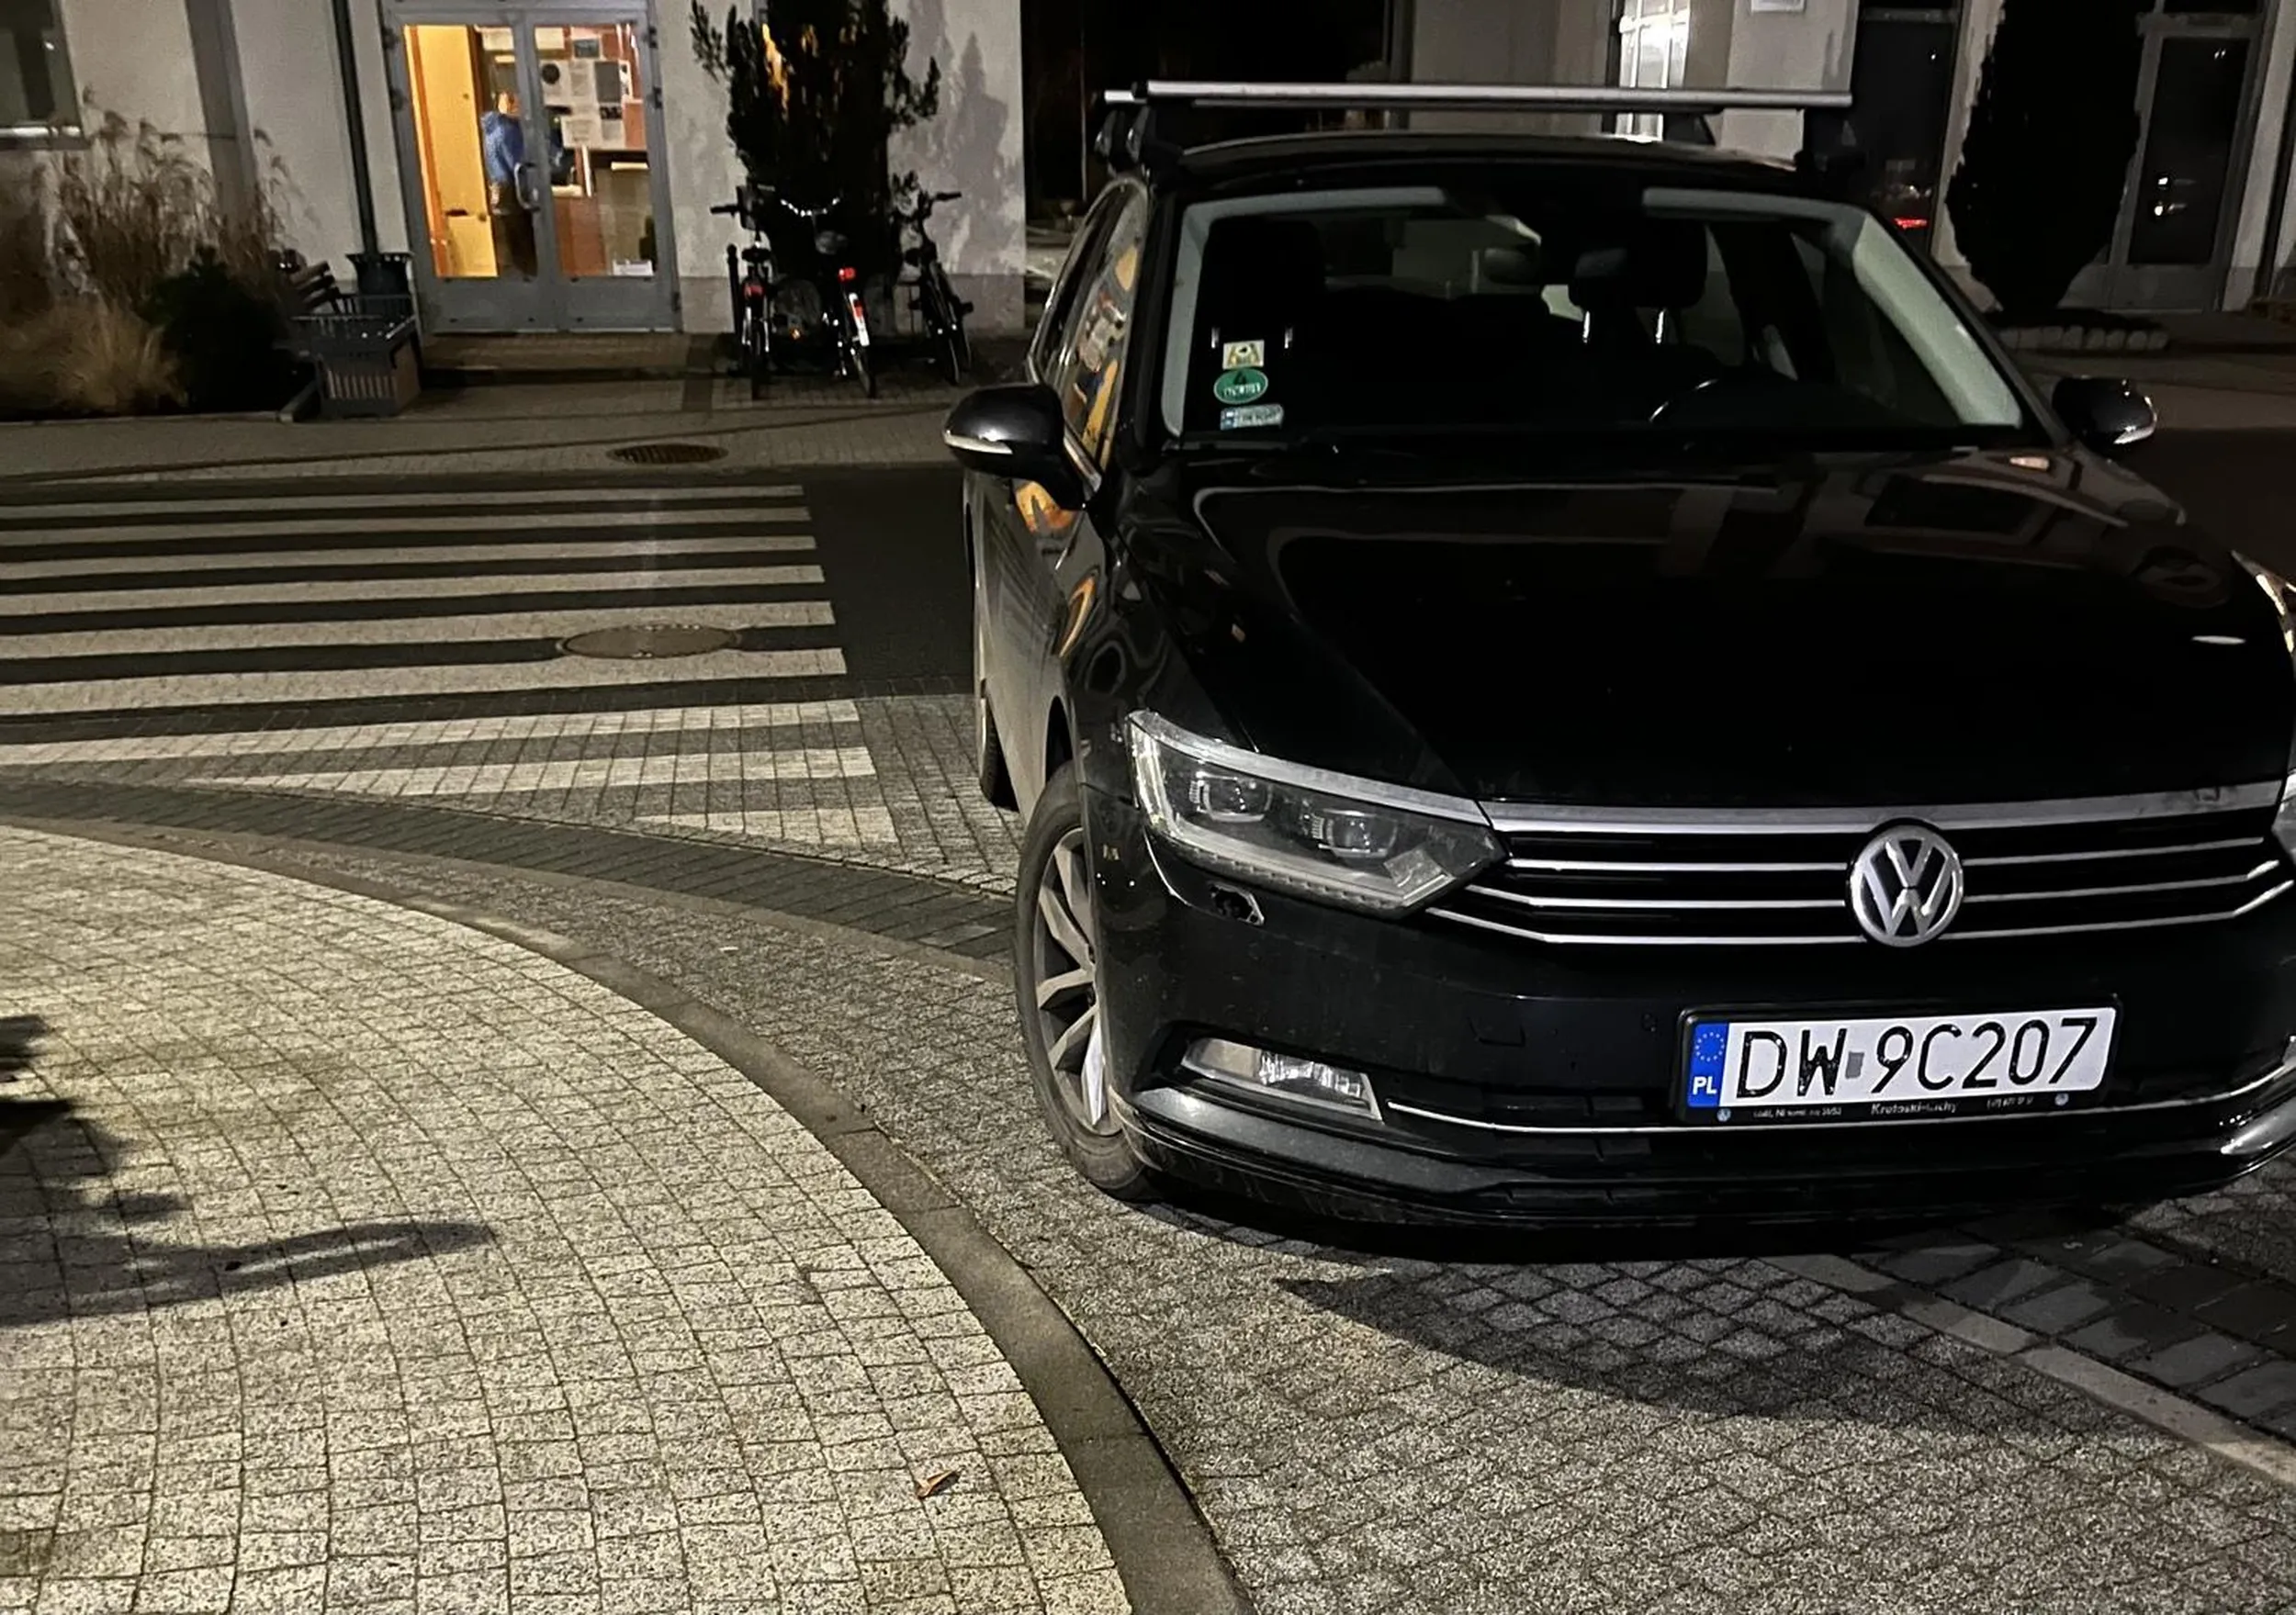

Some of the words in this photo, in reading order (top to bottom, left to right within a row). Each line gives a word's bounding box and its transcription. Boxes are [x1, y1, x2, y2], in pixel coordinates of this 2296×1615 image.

[1737, 1028, 1847, 1099] DW
[1871, 1016, 2098, 1094] 9C207
[1693, 1076, 1717, 1095] PL
